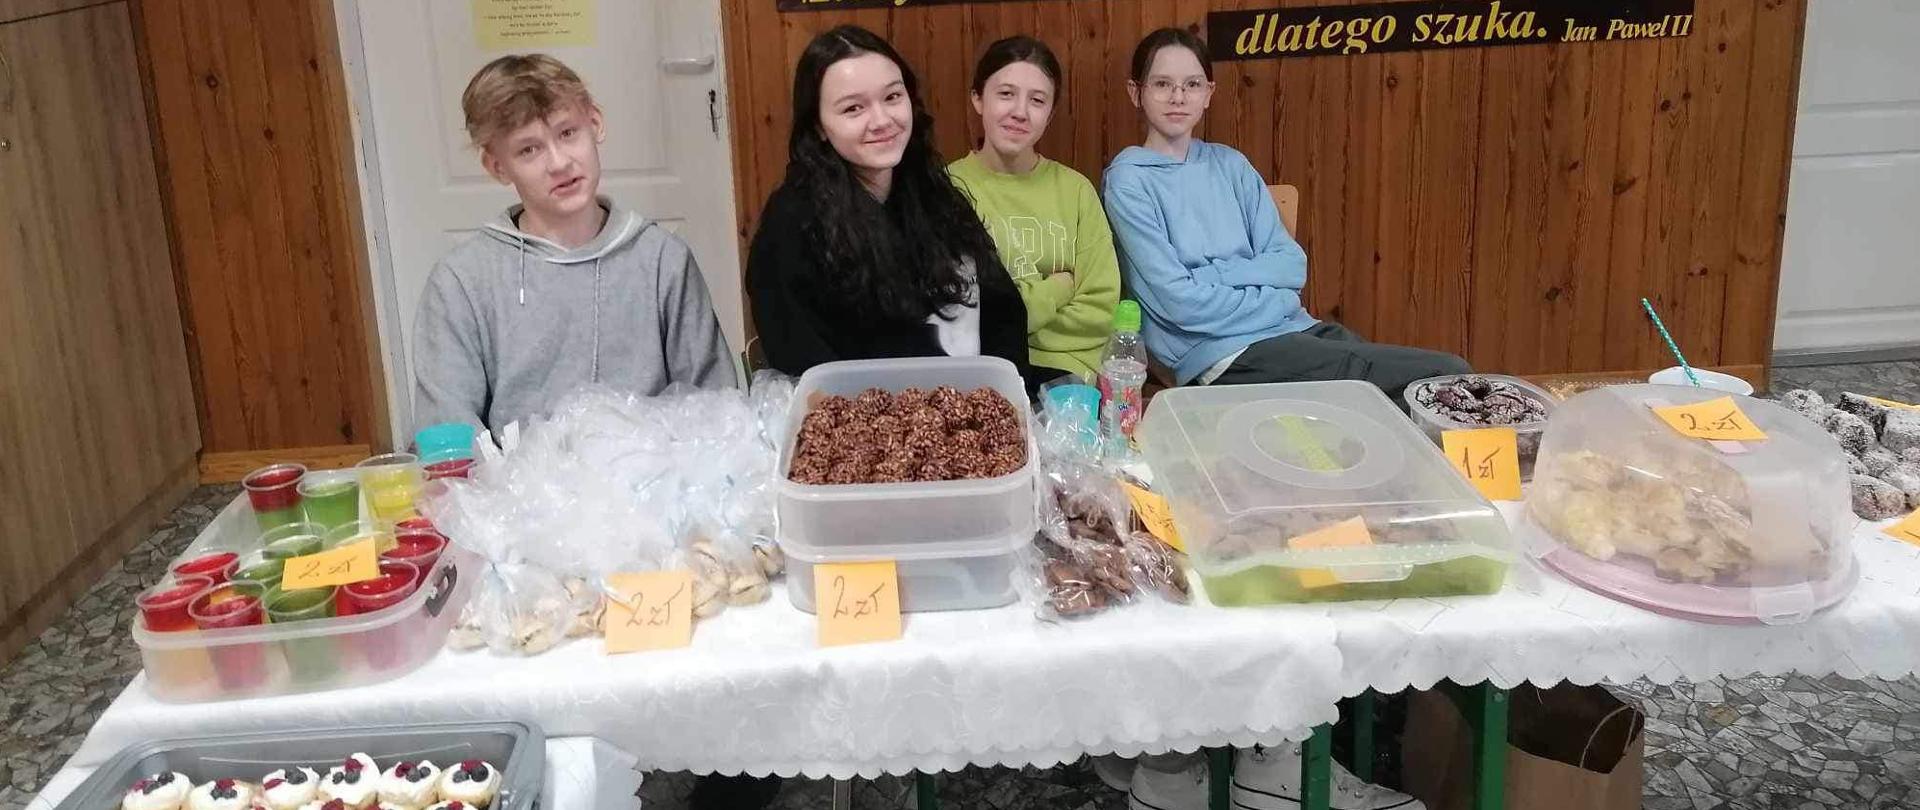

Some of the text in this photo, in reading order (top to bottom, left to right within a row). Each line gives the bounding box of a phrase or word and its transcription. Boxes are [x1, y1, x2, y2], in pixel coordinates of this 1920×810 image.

[1235, 13, 1397, 55] dlatego
[1412, 0, 1547, 45] szuka.
[1561, 18, 1598, 42] Jan
[1462, 447, 1472, 479] 1
[626, 591, 644, 627] 2
[833, 575, 848, 619] 2
